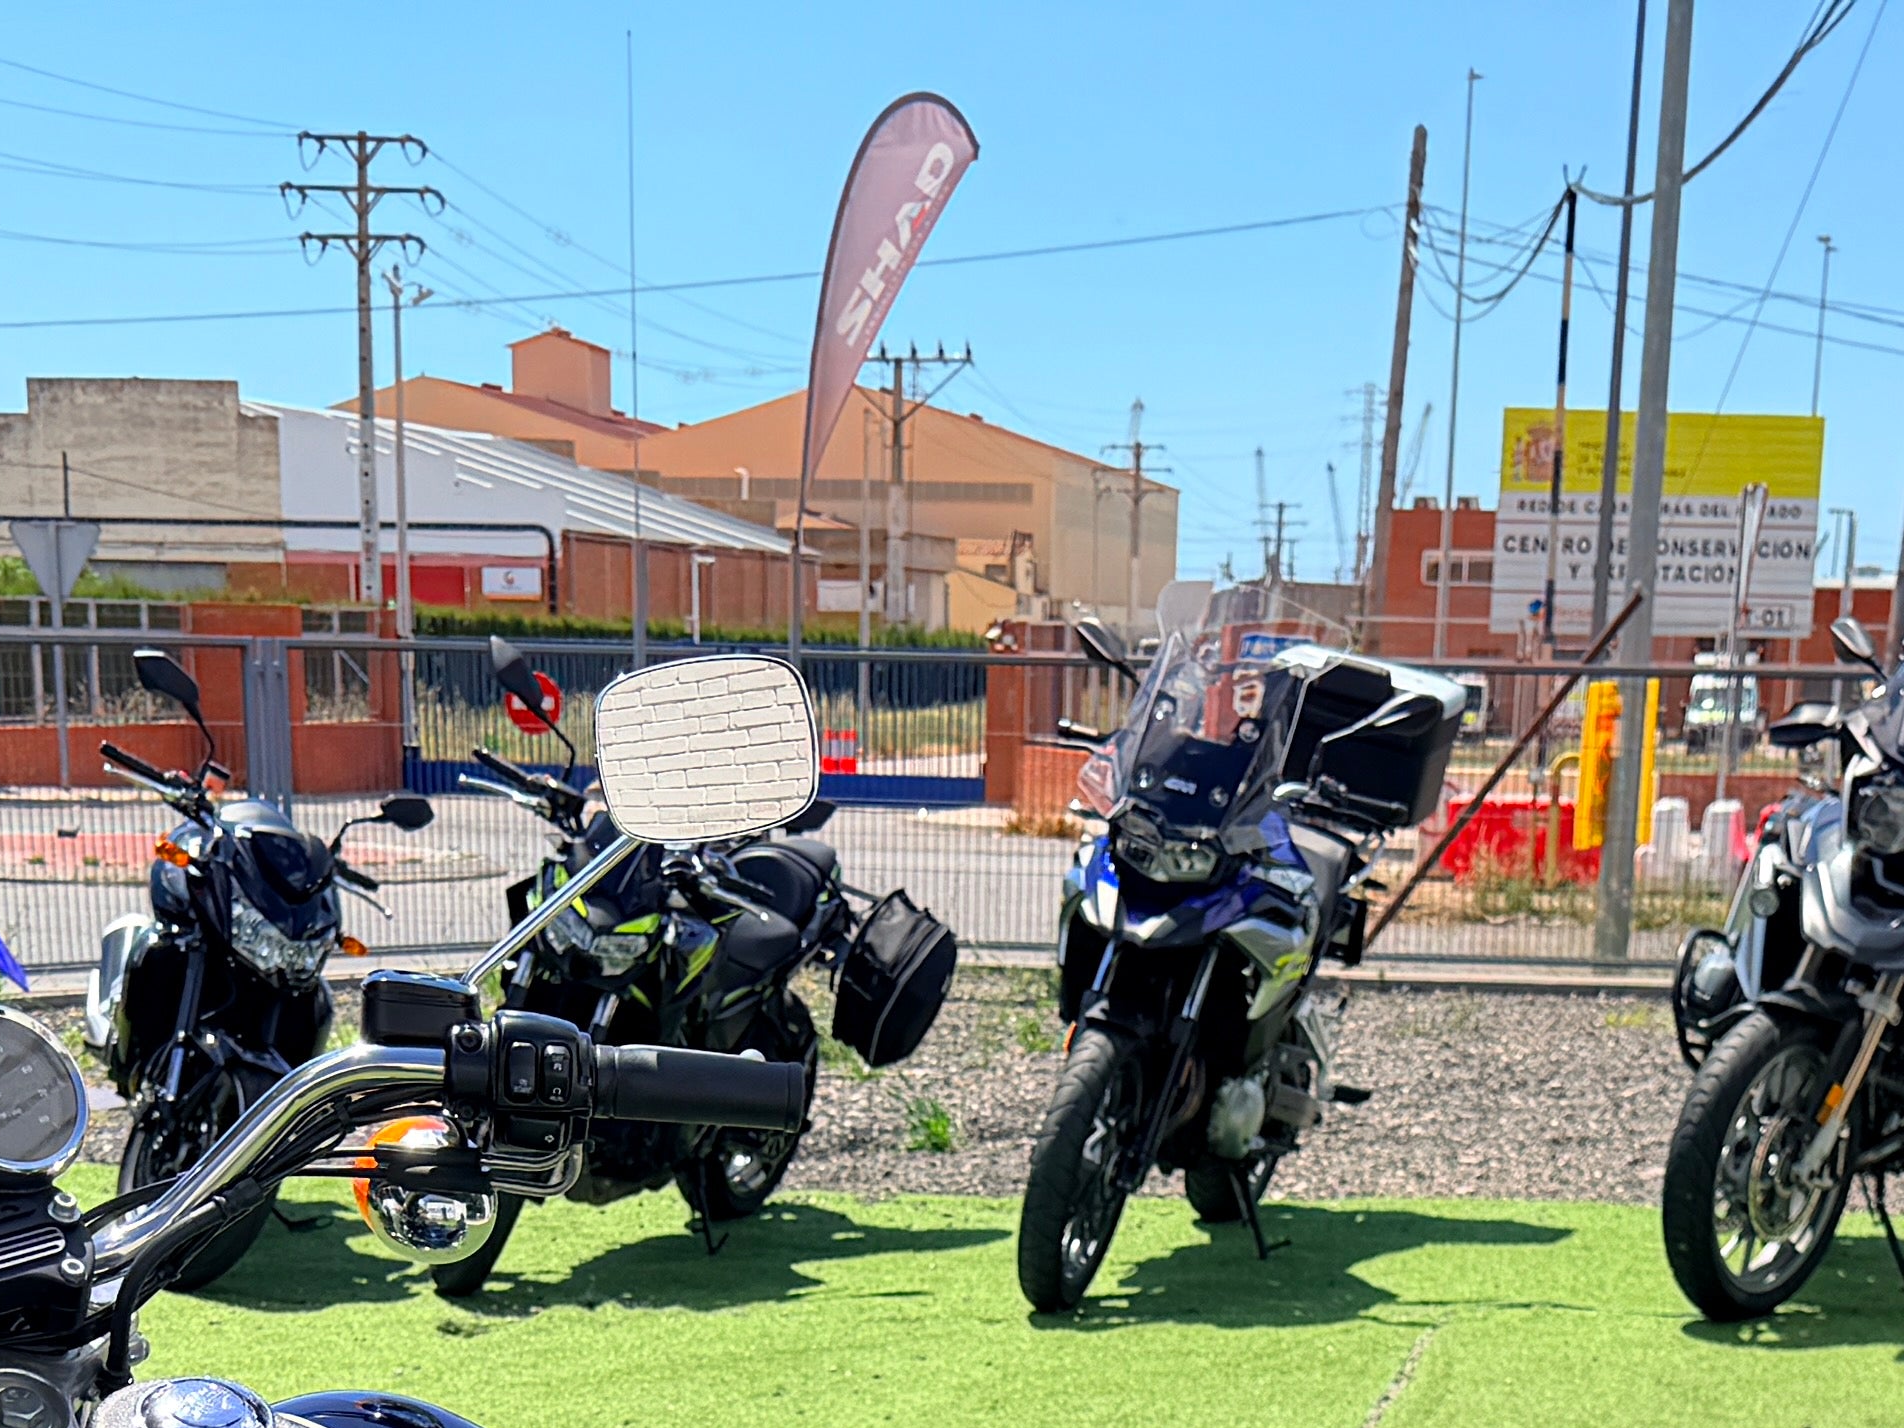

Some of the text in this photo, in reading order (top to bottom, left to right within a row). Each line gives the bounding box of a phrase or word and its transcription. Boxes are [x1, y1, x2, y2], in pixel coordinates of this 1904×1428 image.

[836, 141, 955, 348] SHAD
[1503, 535, 1592, 554] CENRO
[1657, 536, 1812, 560] ONSERCIÓN
[1568, 563, 1581, 580] Y
